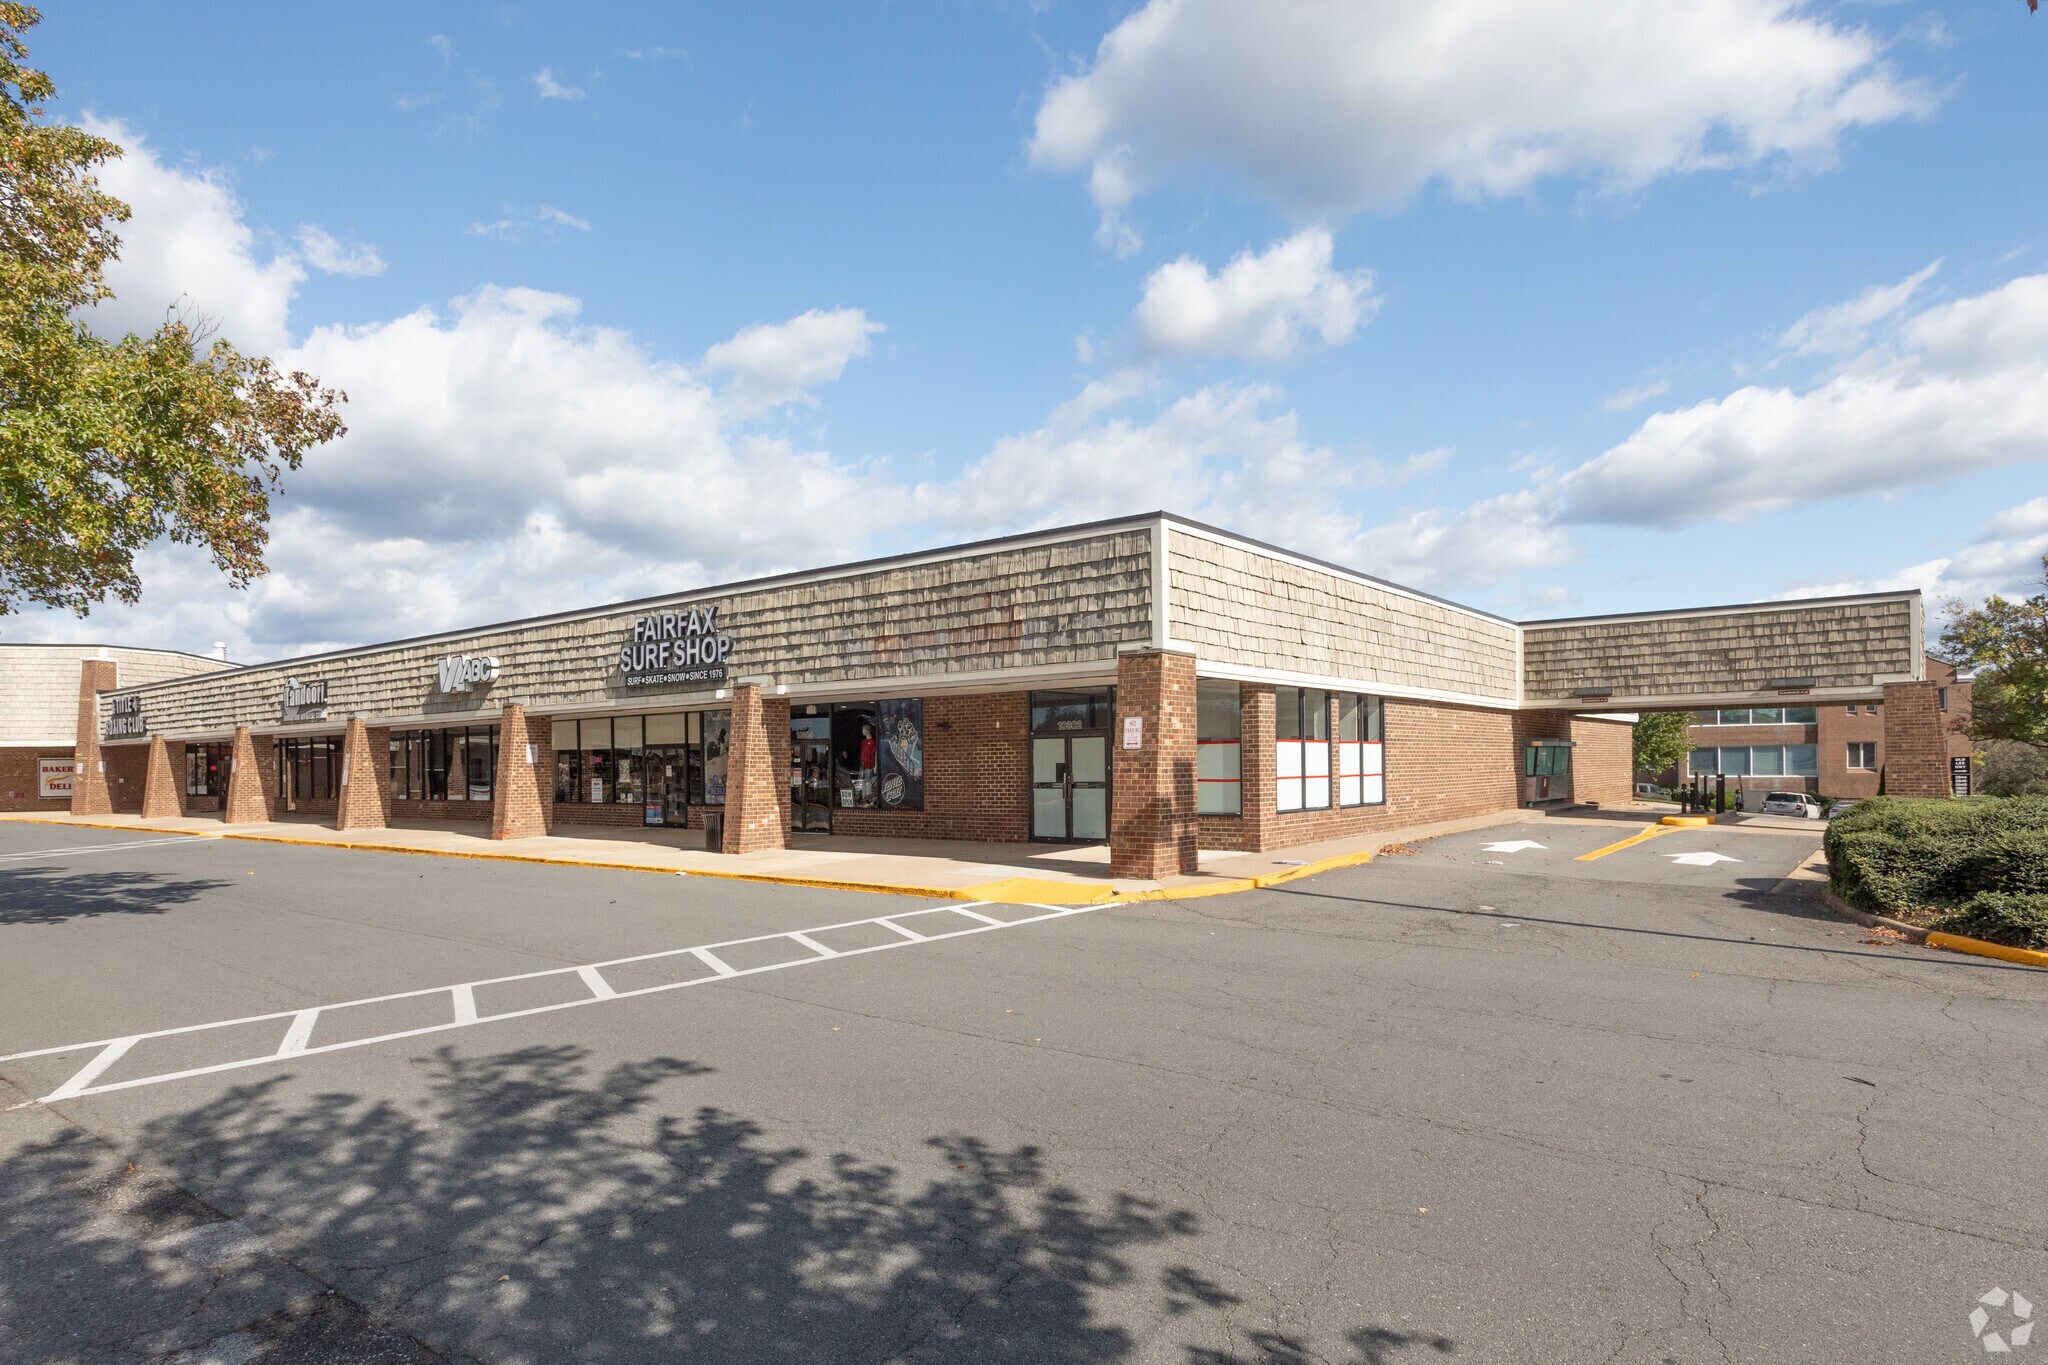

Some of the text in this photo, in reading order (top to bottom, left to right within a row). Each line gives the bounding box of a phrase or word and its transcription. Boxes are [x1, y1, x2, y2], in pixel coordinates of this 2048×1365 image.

[634, 606, 716, 642] FAIRFAX
[620, 636, 731, 672] SURF SHOP
[458, 657, 491, 683] ABC
[627, 669, 723, 685] SURF SKATE SNOW SINCE 1976
[285, 682, 324, 707] Tandoori
[127, 716, 144, 734] CLUB
